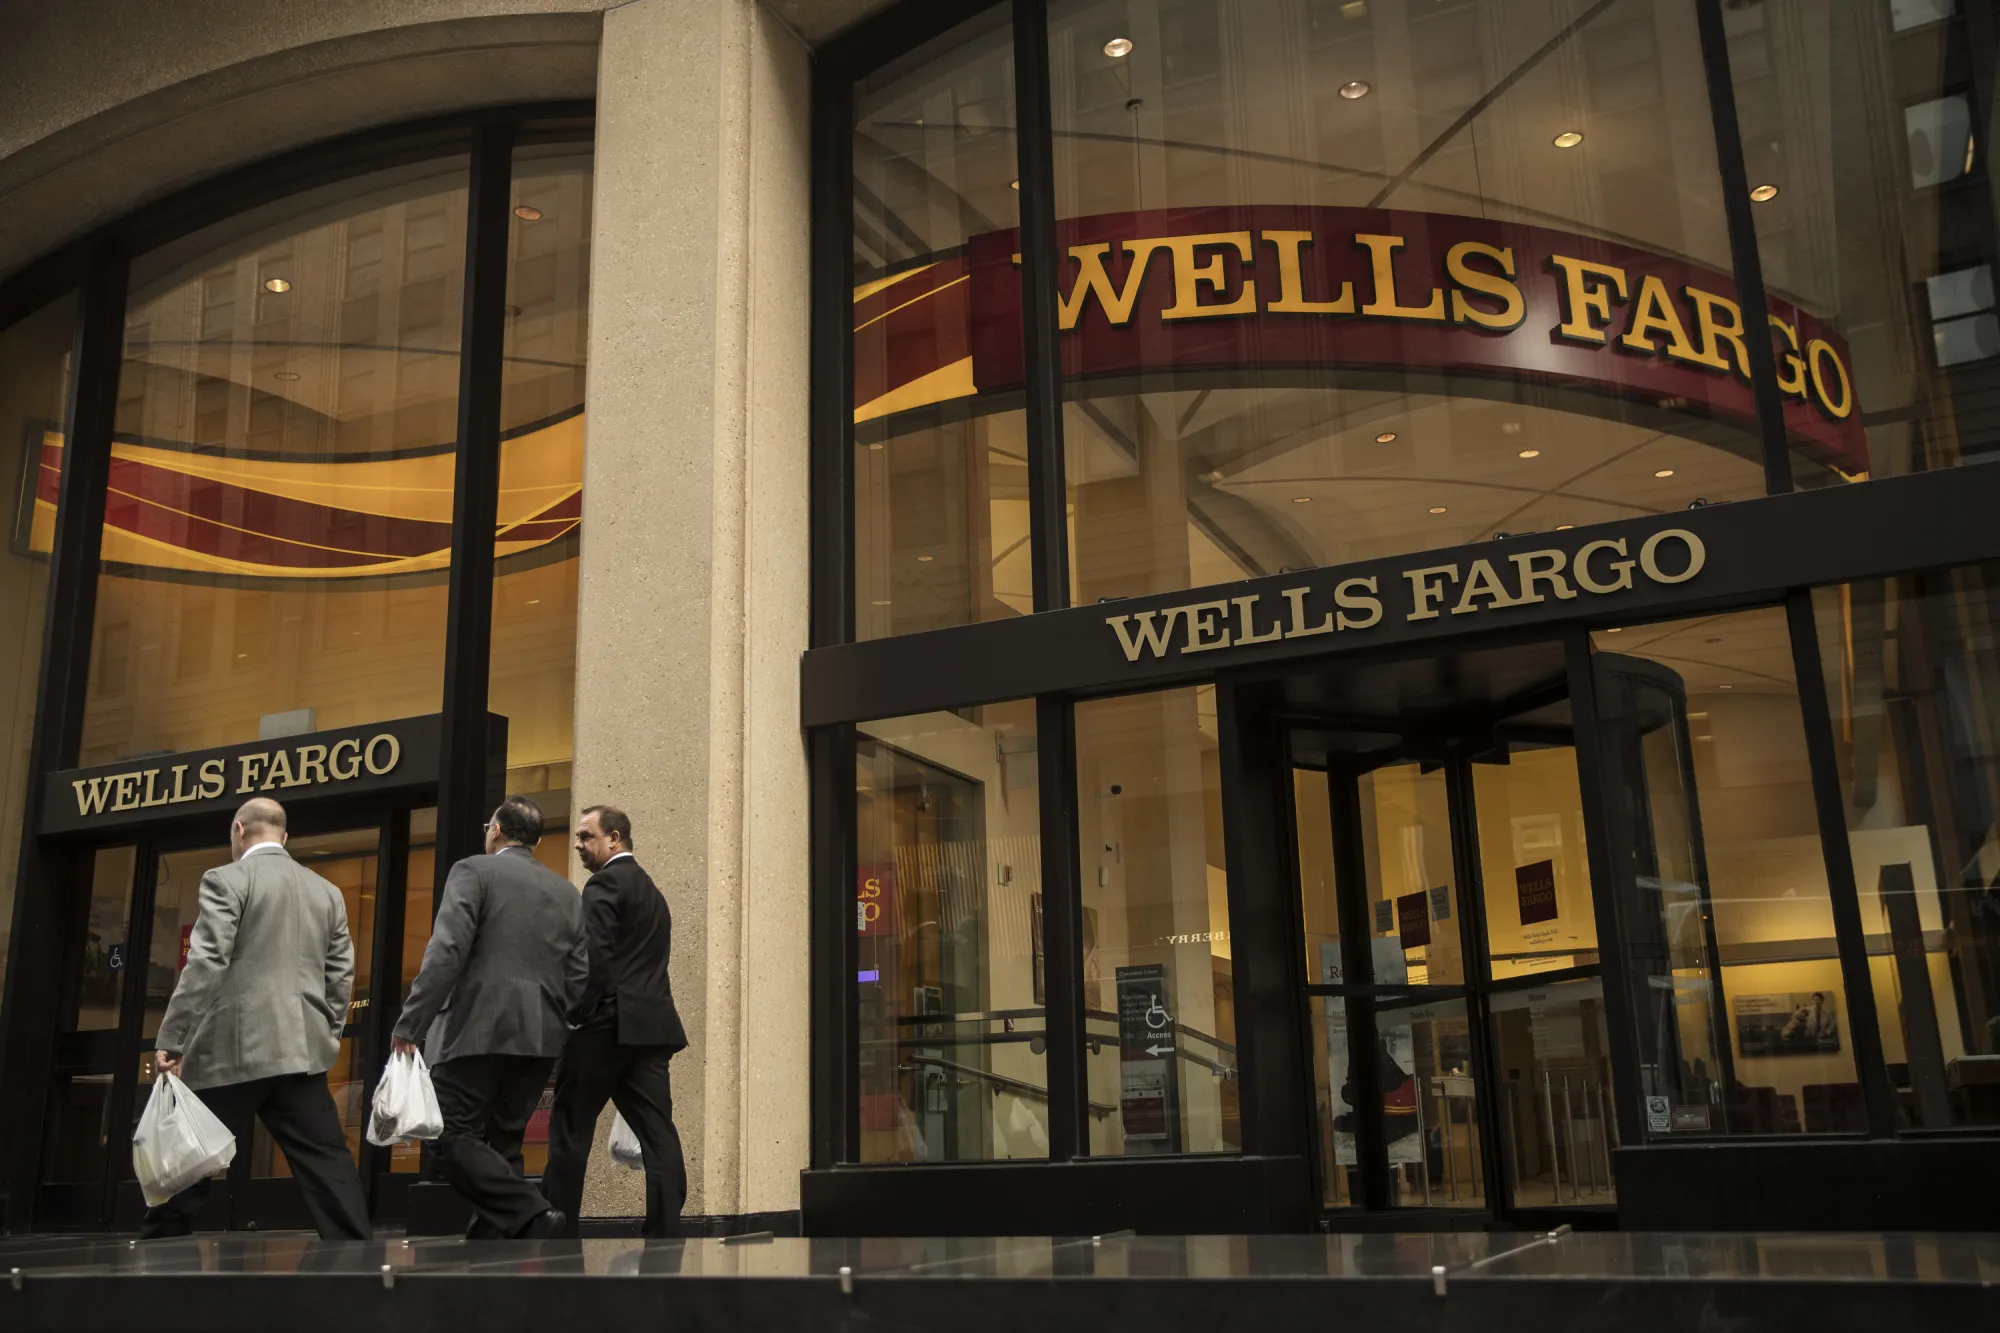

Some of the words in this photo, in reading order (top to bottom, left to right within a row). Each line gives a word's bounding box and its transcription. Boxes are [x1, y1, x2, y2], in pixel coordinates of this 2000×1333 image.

[1012, 229, 1525, 331] WELLS
[1551, 254, 1853, 418] FARGO
[1105, 576, 1383, 662] WELLS
[1402, 528, 1706, 621] FARGO
[72, 759, 226, 816] WELLS
[235, 733, 401, 795] FARGO
[1147, 1031, 1172, 1040] Access
